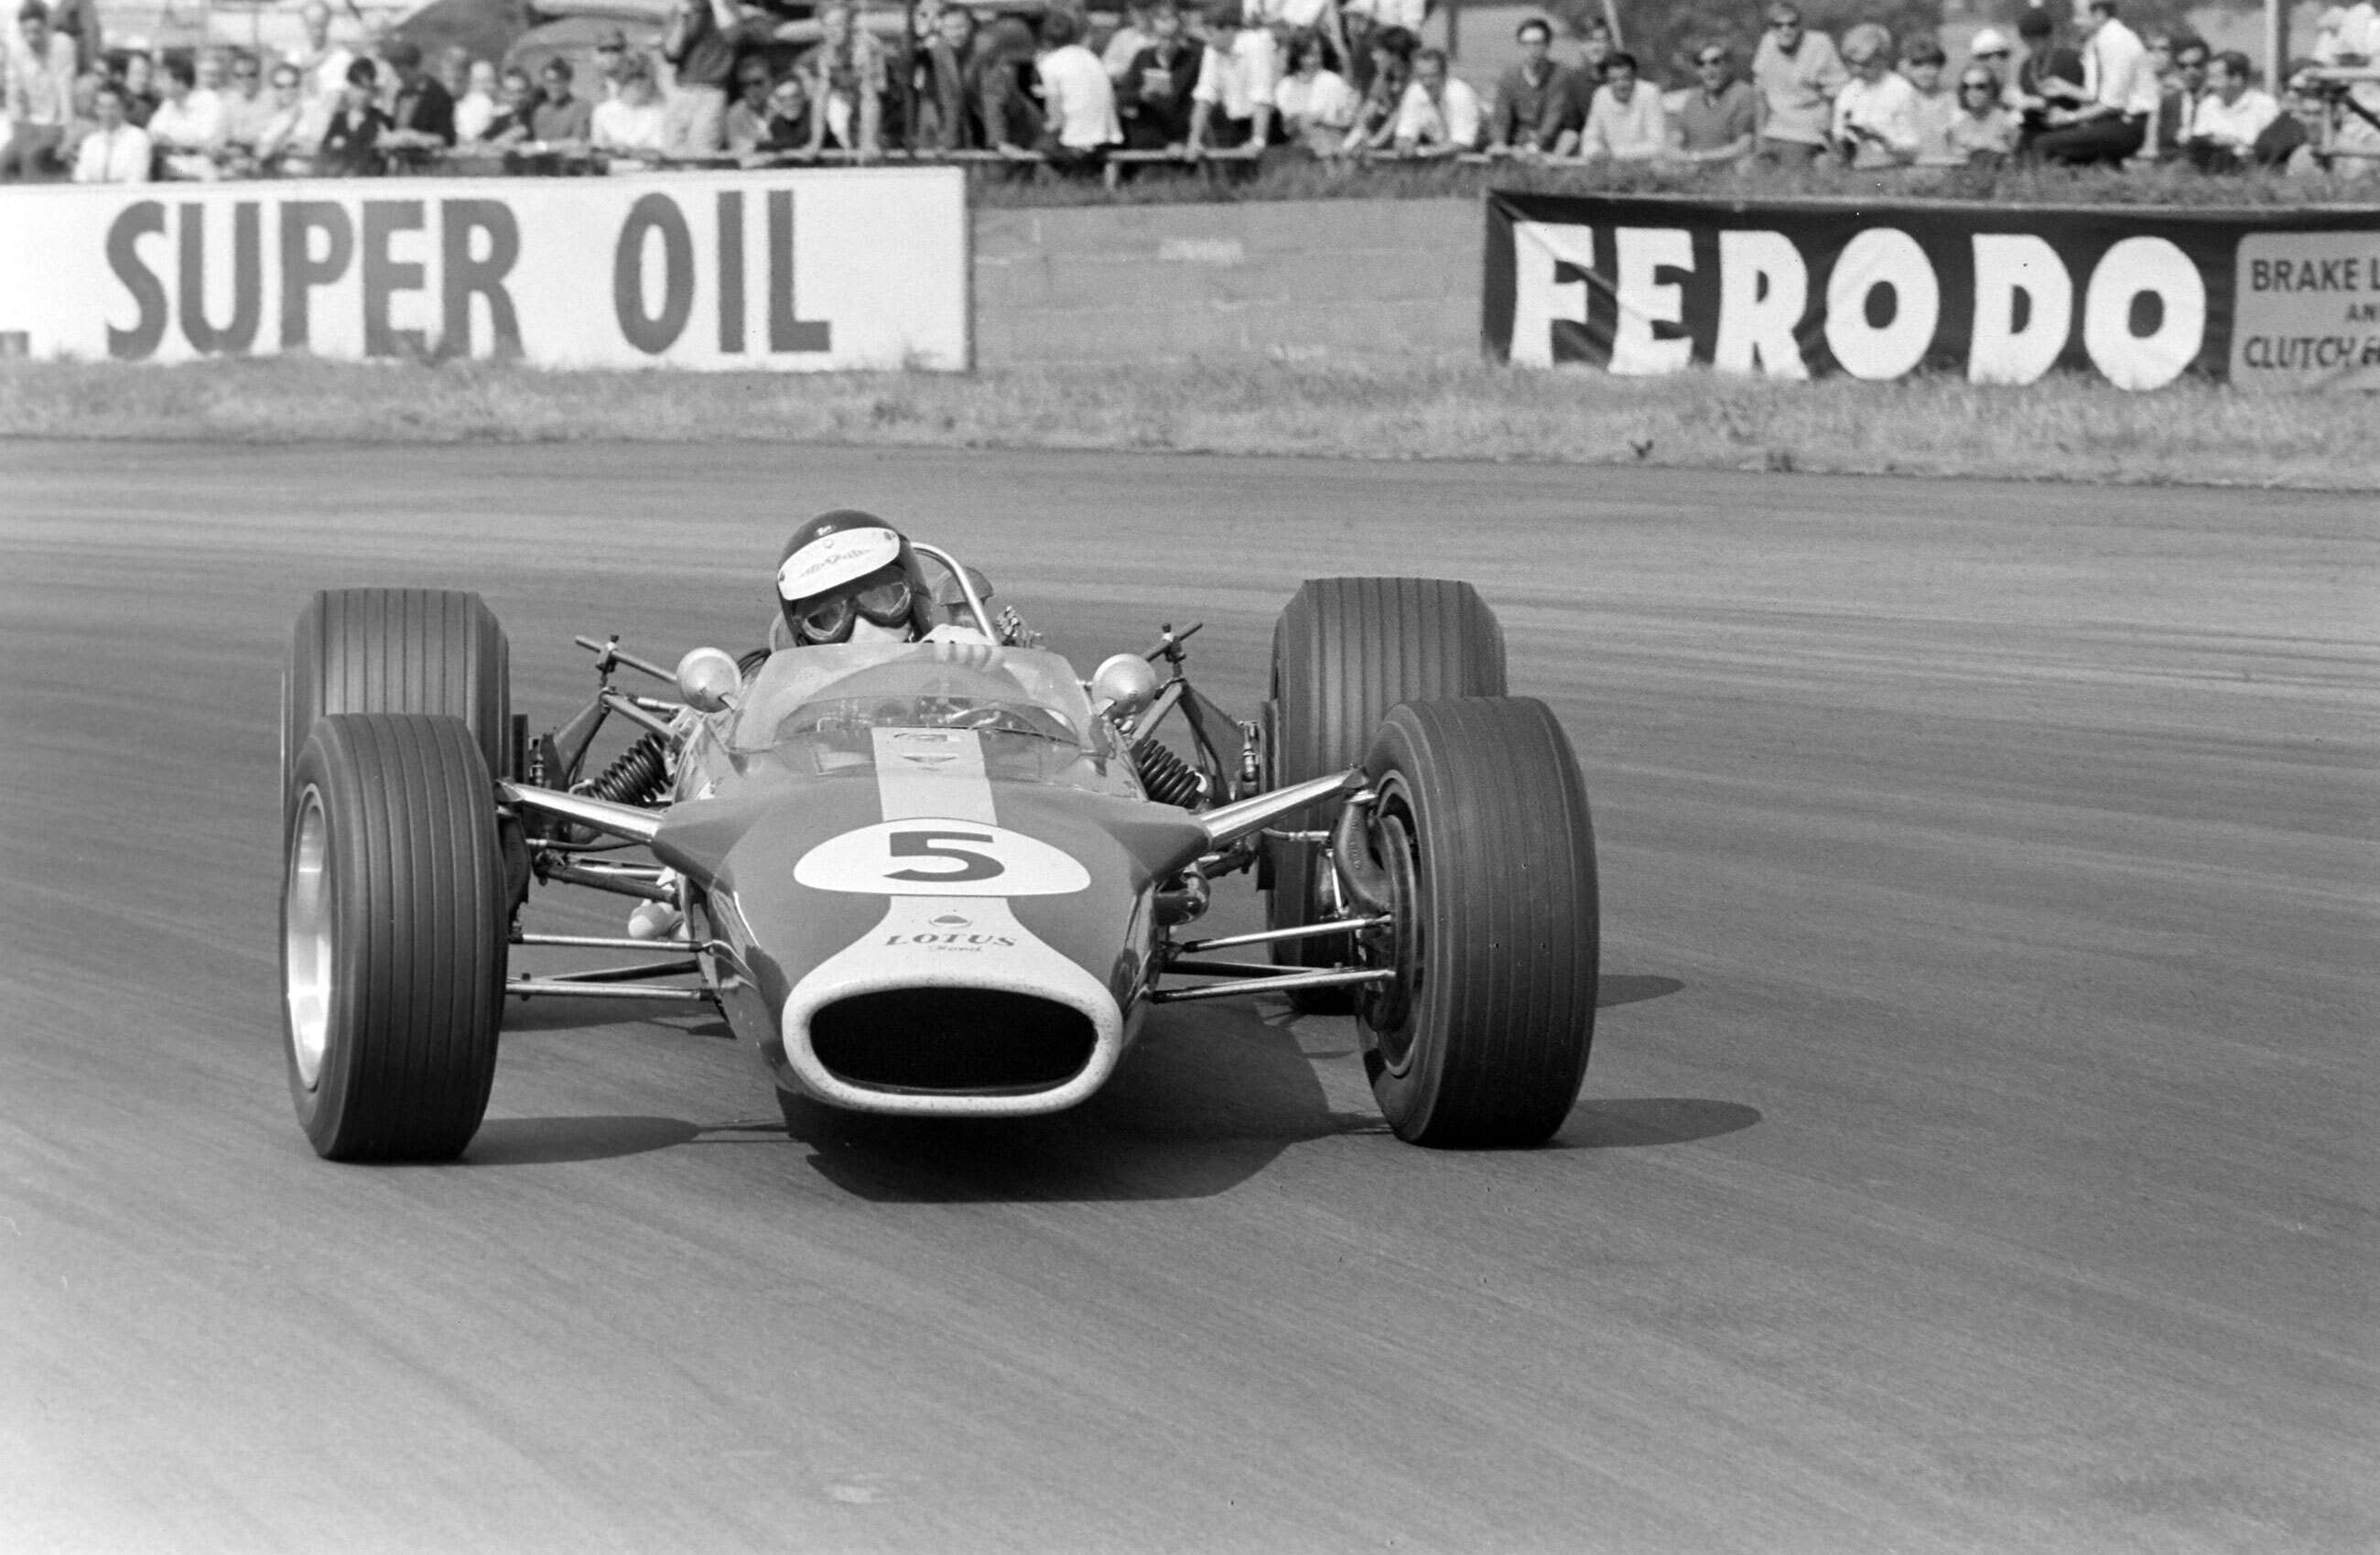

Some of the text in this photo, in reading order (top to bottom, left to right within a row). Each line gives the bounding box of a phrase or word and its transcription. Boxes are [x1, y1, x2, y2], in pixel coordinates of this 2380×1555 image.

[105, 189, 833, 361] SUPER OIL
[2251, 258, 2360, 292] BRAKE
[1509, 221, 2207, 391] FERODO
[2243, 334, 2356, 369] CLUTCH
[883, 831, 1006, 882] 5
[884, 933, 1018, 946] LOTUS
